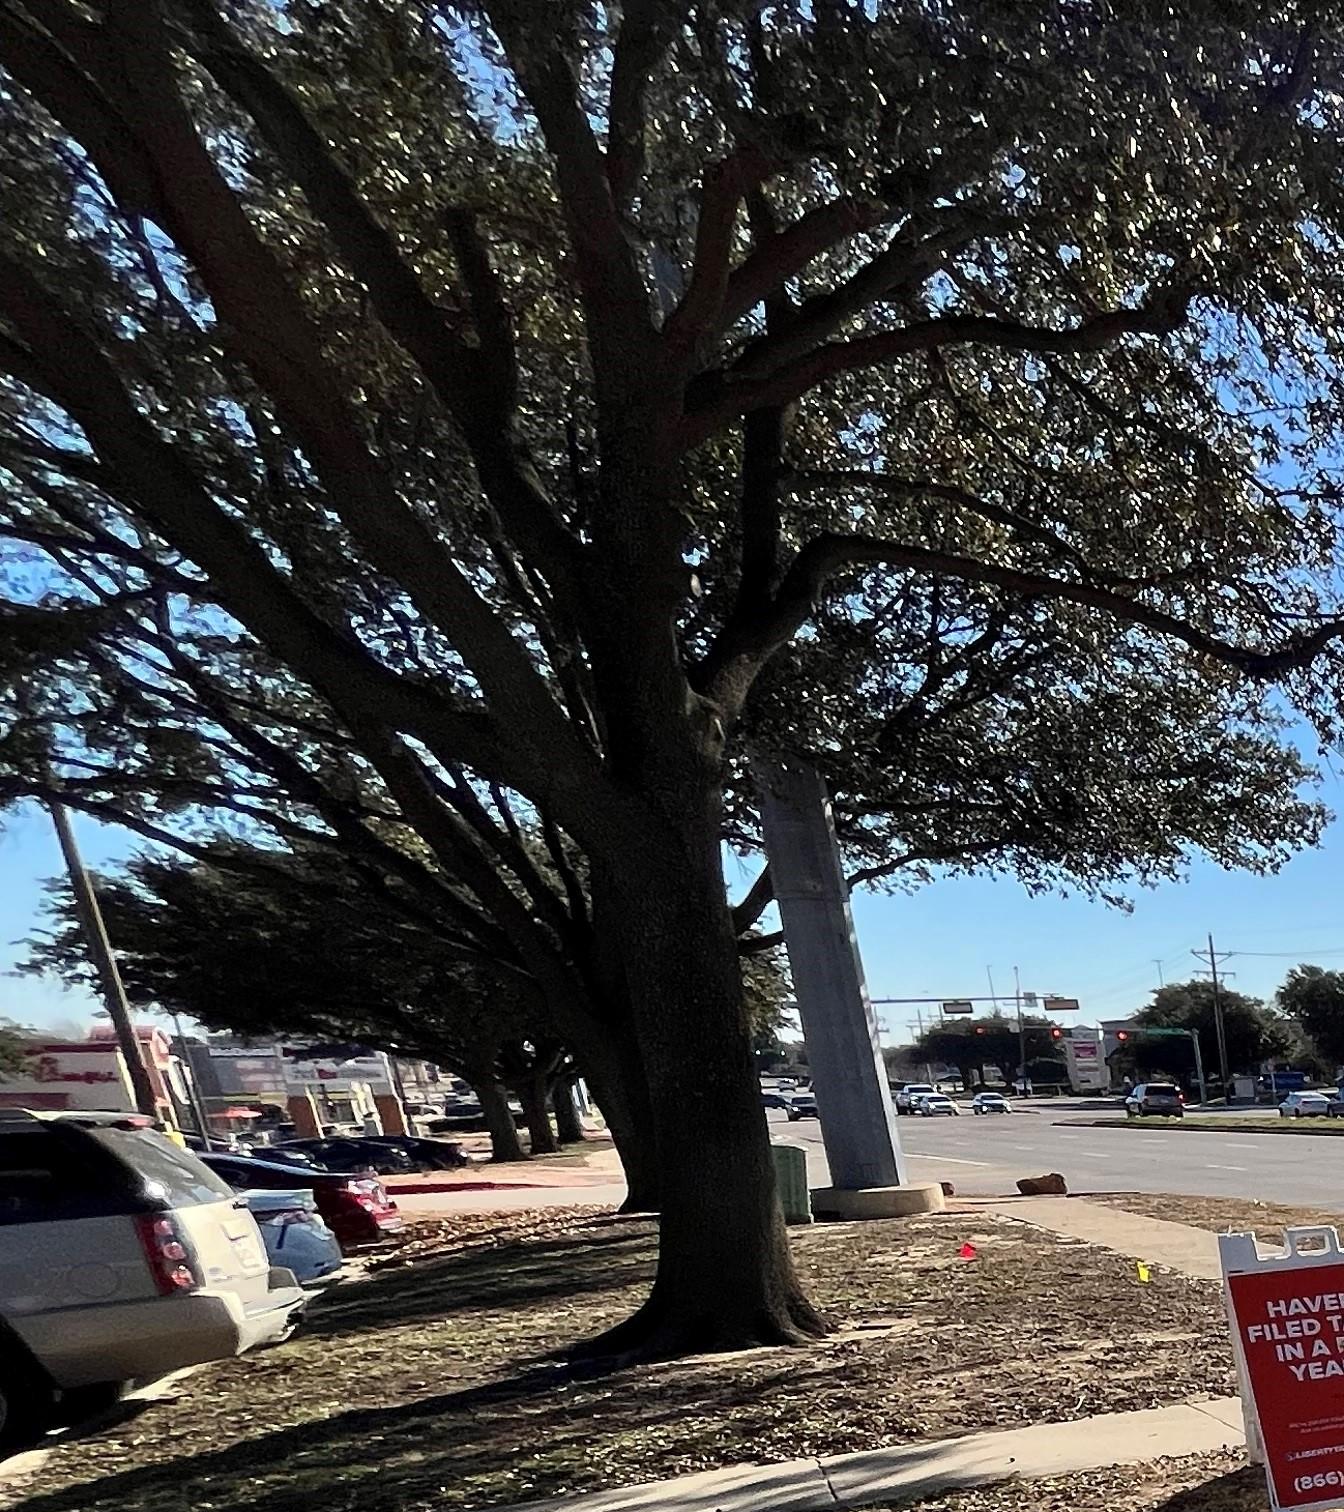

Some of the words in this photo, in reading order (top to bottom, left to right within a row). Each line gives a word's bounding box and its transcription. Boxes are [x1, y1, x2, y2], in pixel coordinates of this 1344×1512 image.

[1247, 1318, 1321, 1343] FILED
[1275, 1342, 1304, 1362] IN
[1311, 1340, 1331, 1358] A
[1294, 1471, 1344, 1492] (866)
